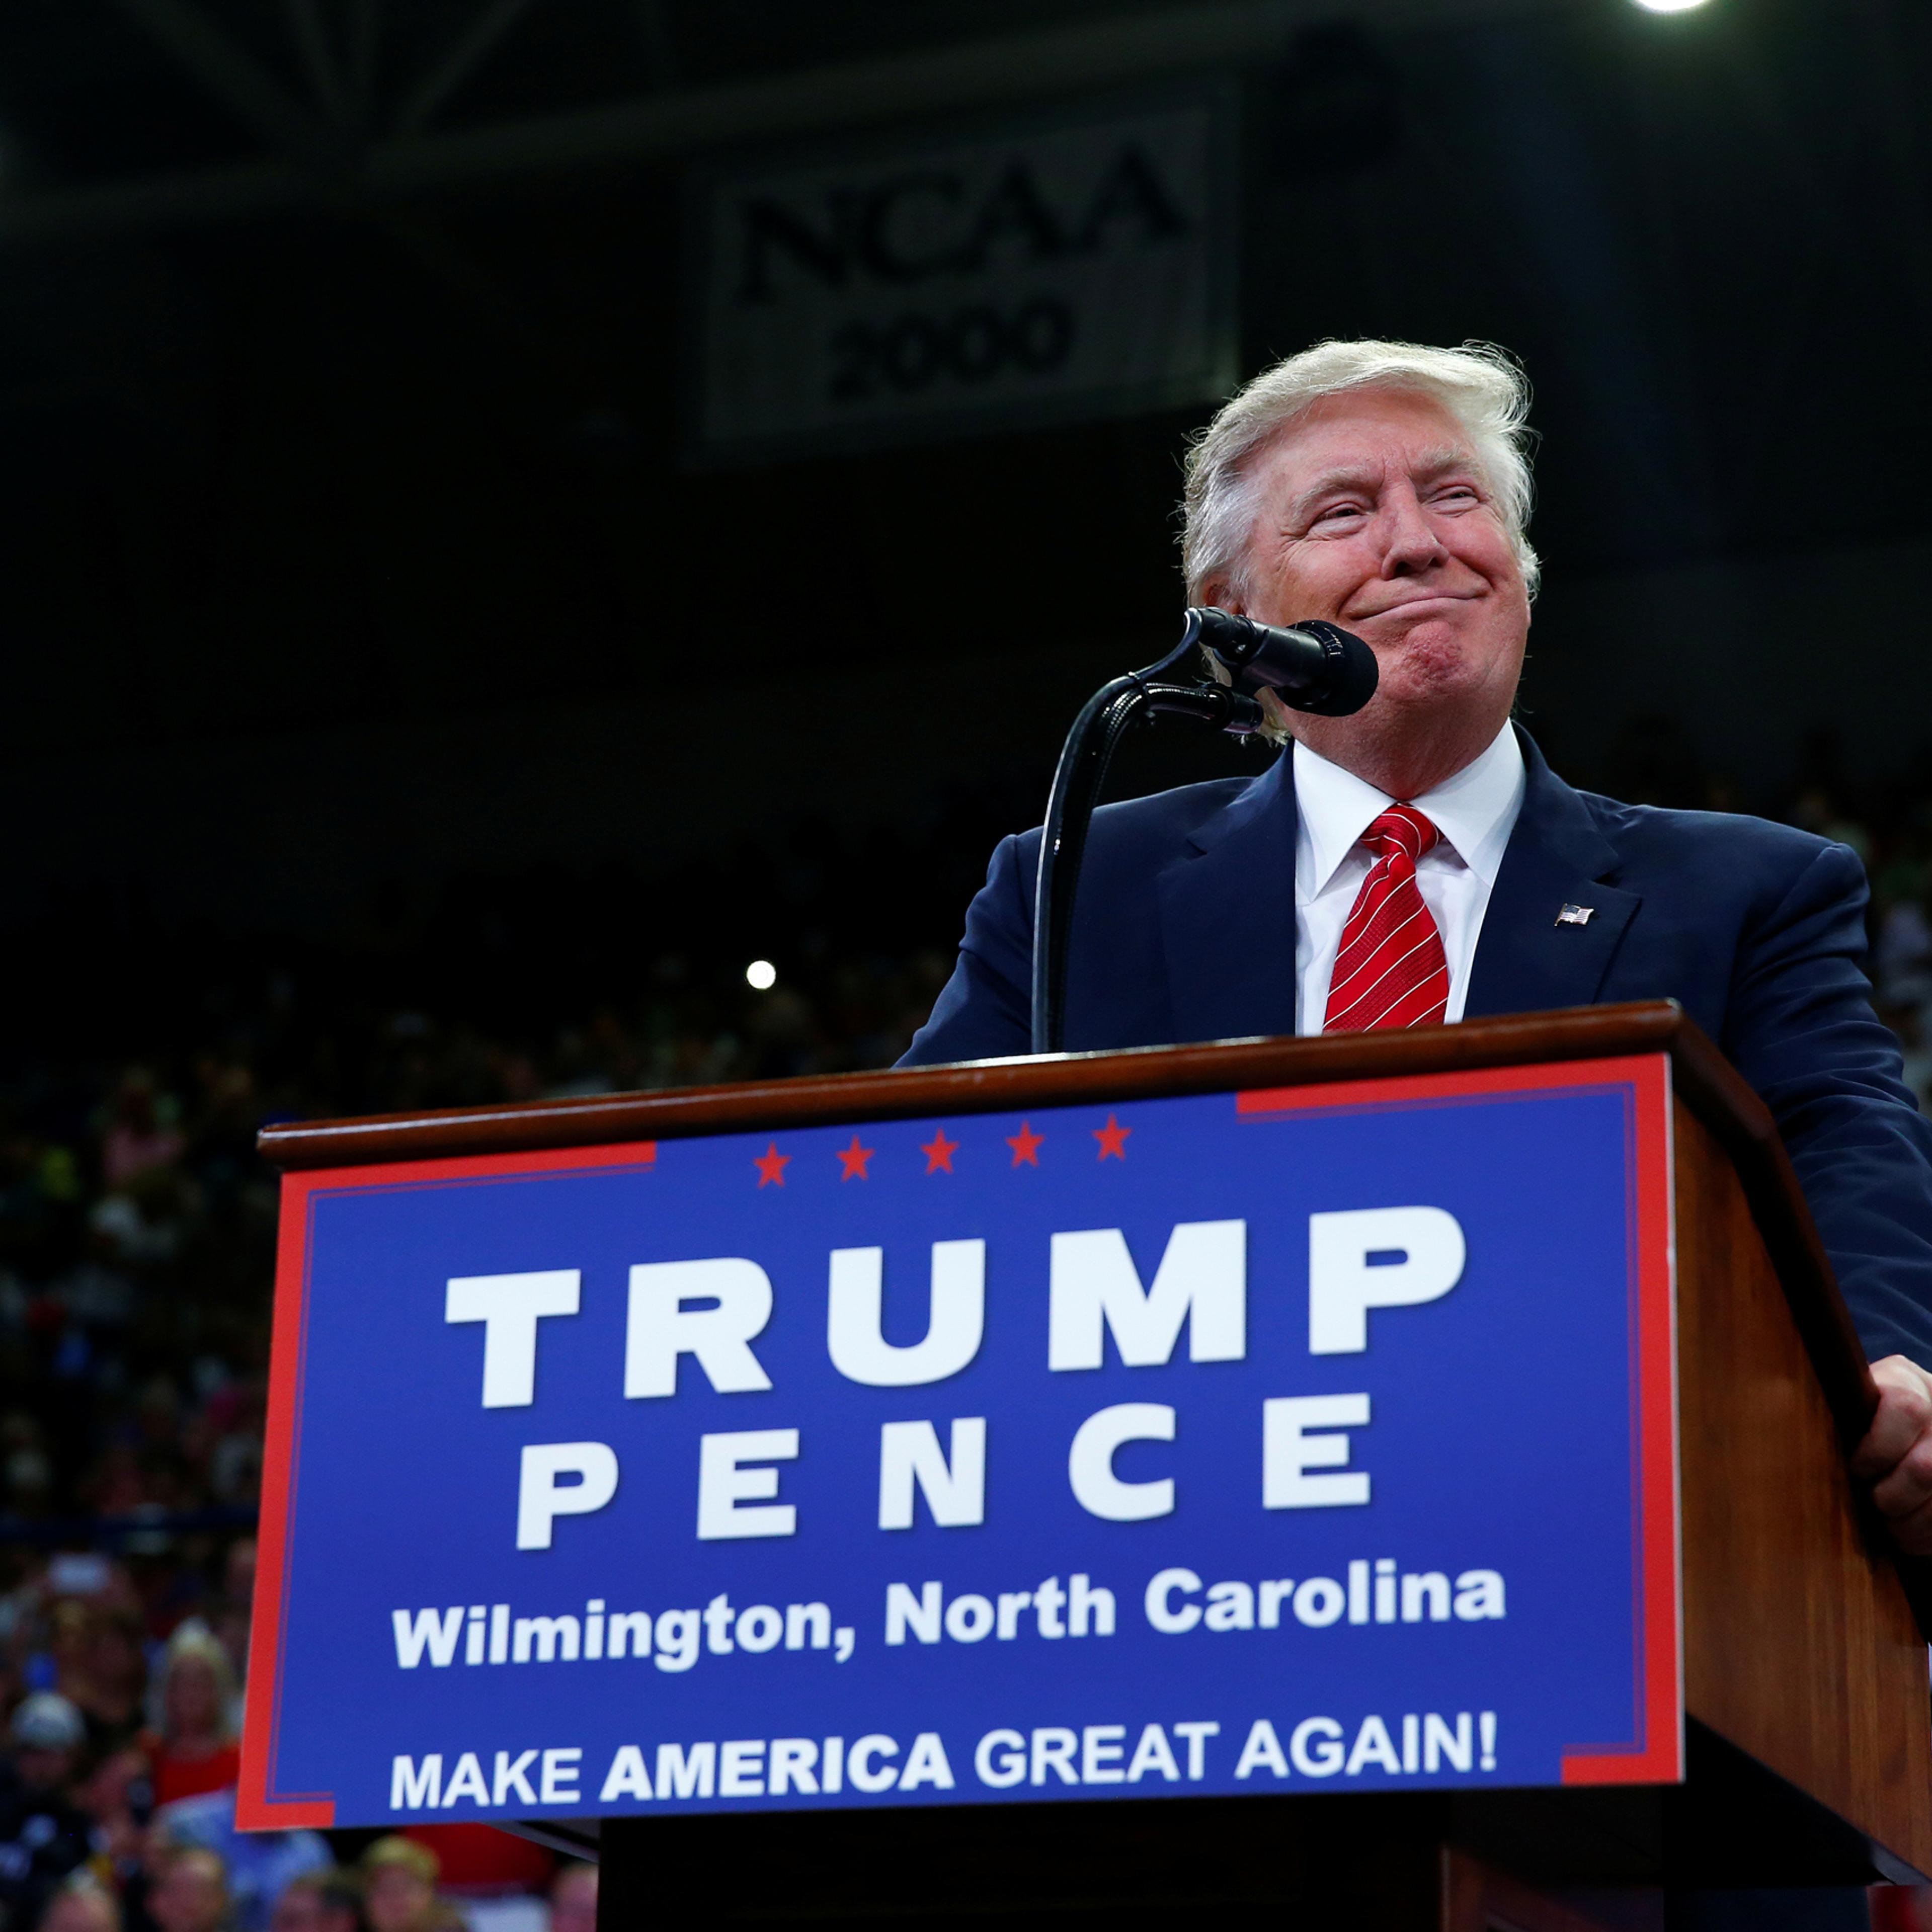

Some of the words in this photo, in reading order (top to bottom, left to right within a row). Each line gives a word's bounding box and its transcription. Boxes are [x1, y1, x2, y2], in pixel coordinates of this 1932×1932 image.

[739, 143, 1188, 304] NCAA
[831, 297, 1072, 400] 2000
[445, 1205, 1466, 1408] TRUMP
[517, 1392, 1370, 1550] PENCE
[392, 1594, 855, 1672] Wilmington,
[885, 1573, 1115, 1646] North
[1145, 1559, 1505, 1634] Carolina
[390, 1747, 582, 1810] MAKE
[600, 1733, 954, 1802] AMERICA
[974, 1722, 1220, 1788] GREAT
[1234, 1711, 1497, 1779] AGAIN!
